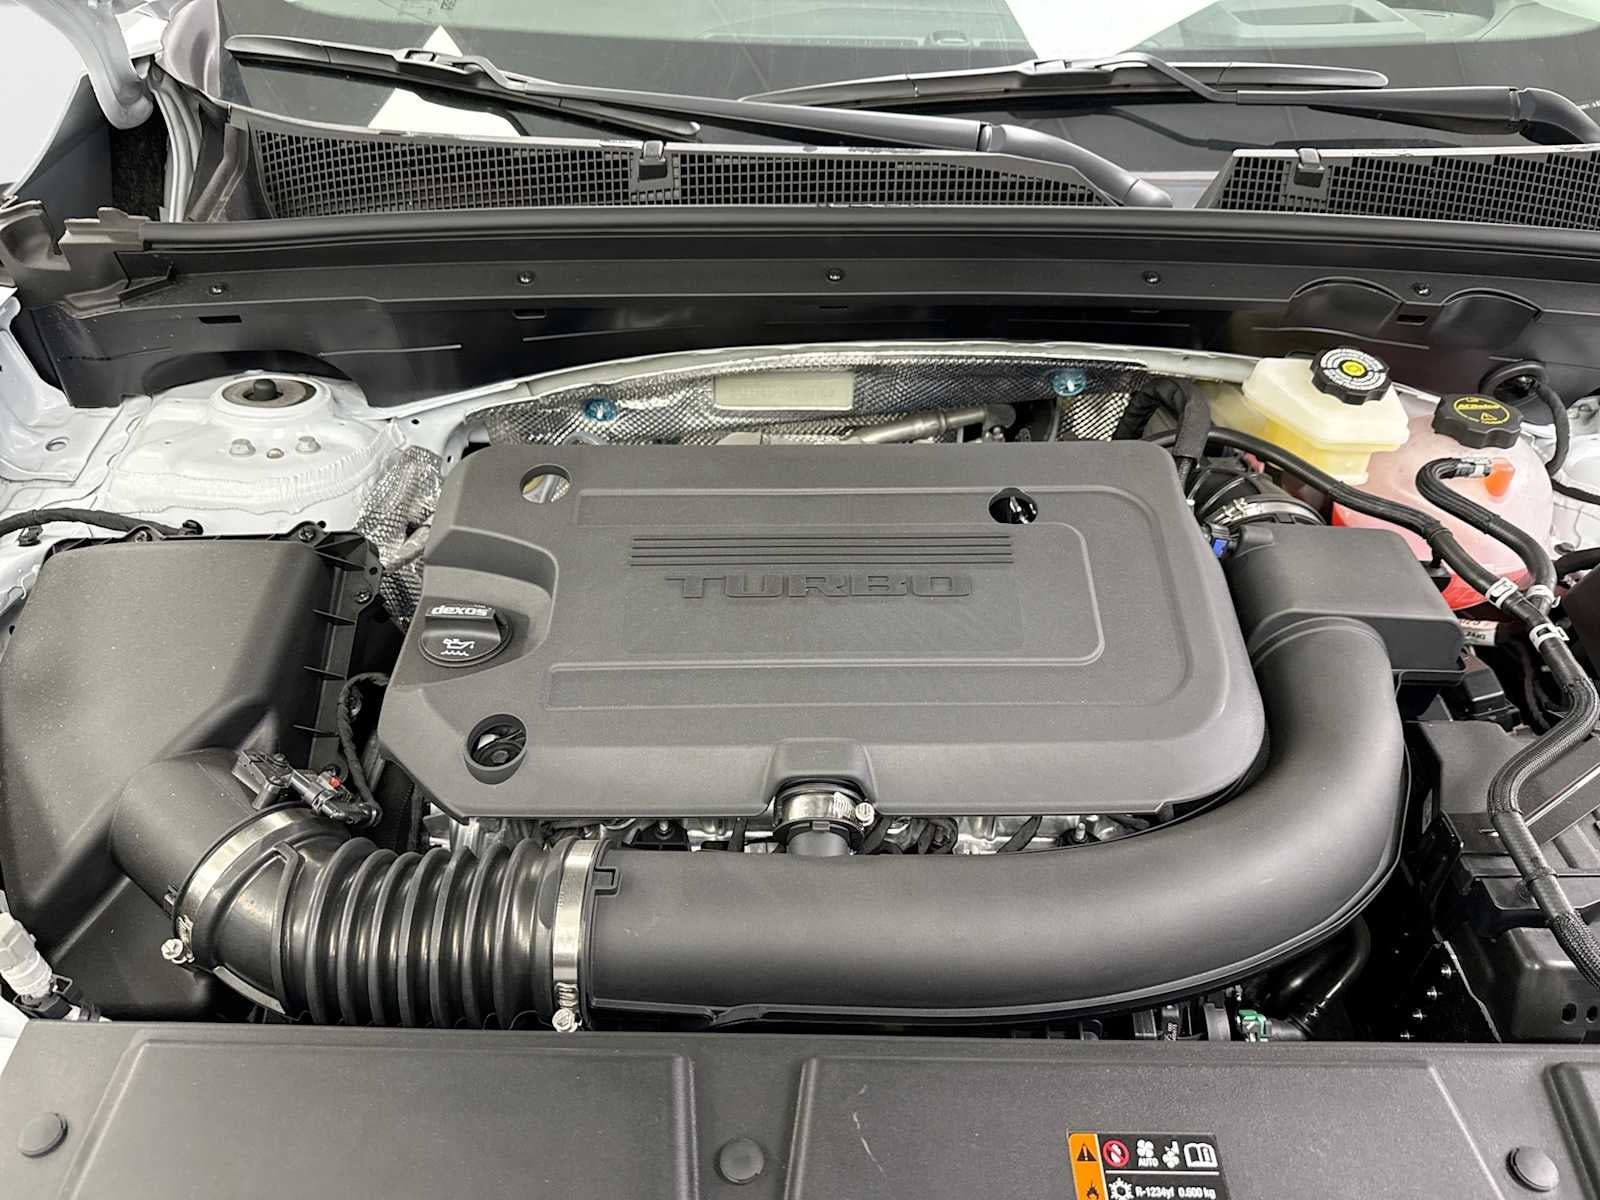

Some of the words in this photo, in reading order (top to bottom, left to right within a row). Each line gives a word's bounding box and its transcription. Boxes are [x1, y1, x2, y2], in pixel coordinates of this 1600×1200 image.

[665, 572, 973, 599] TURBO
[431, 605, 489, 616] dexos
[1138, 1157, 1159, 1167] AUTO
